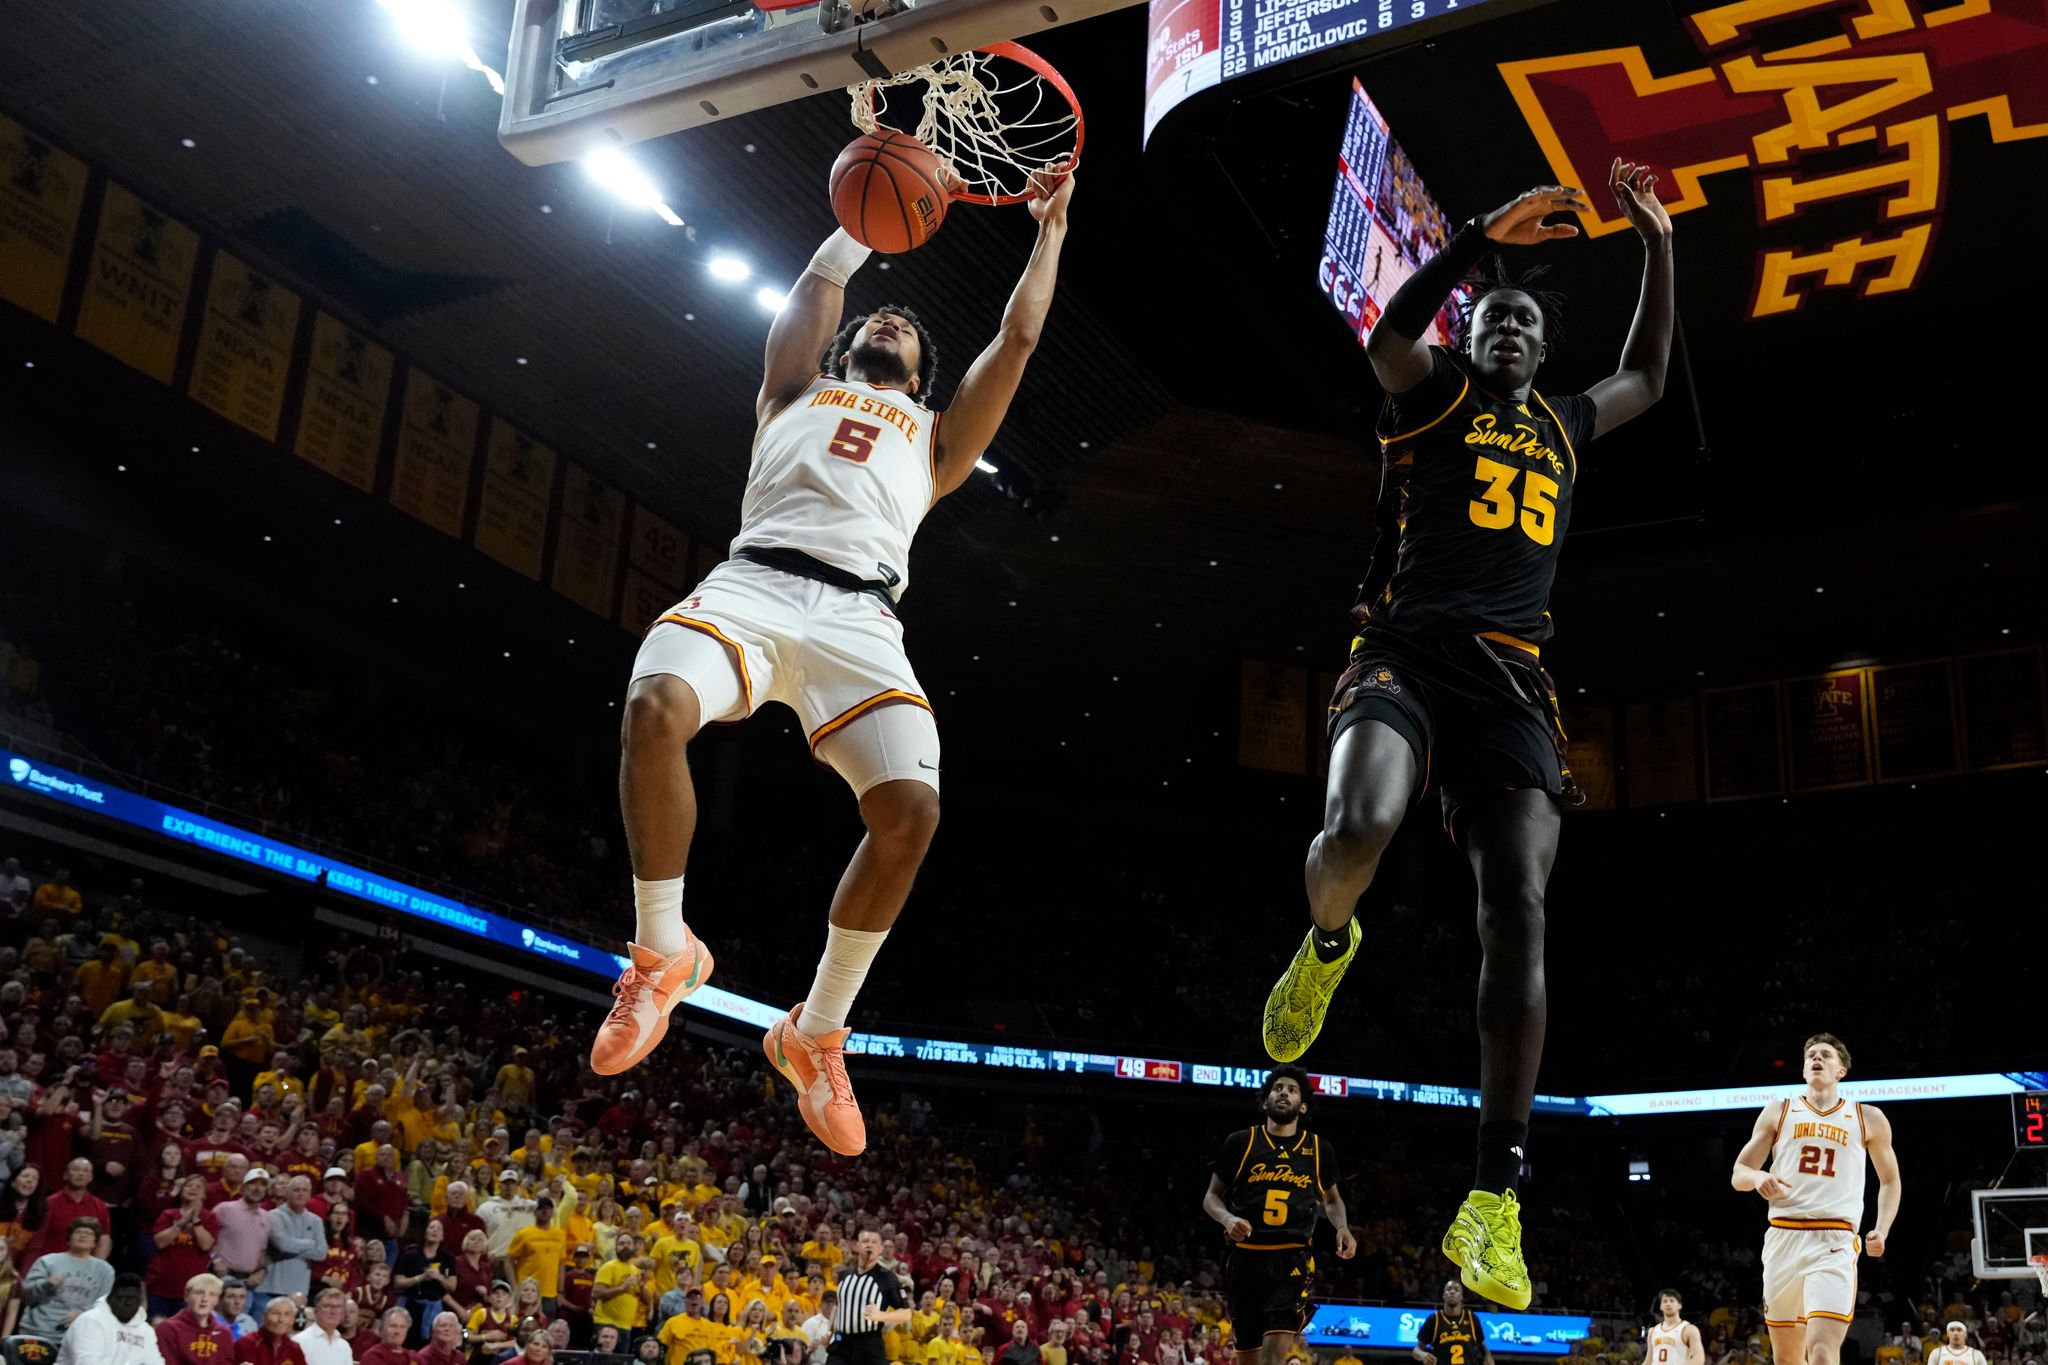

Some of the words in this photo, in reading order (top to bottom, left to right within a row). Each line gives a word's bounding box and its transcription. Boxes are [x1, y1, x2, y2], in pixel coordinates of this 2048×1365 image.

[1230, 10, 1242, 26] 3
[1255, 0, 1314, 18] LIPS
[1223, 57, 1247, 77] 22
[1254, 19, 1367, 68] MOMCILOVIC
[1378, 11, 1393, 29] 8
[1411, 1, 1425, 19] 3
[1224, 41, 1246, 61] 21
[1254, 21, 1312, 51] PLETA
[1230, 26, 1242, 42] 5
[1175, 41, 1204, 70] ISU
[1182, 69, 1193, 92] 7
[808, 388, 859, 409] IOWA
[860, 398, 919, 446] STATE
[827, 417, 882, 465] 5
[1469, 455, 1560, 546] 35
[163, 815, 261, 858] EXPERIENCE
[264, 848, 294, 869] THE
[296, 858, 363, 892] BAKERS
[366, 882, 408, 906] TRUST
[410, 893, 488, 932] DIFFERENCE
[712, 995, 751, 1017] LENDING
[1121, 1058, 1146, 1078] 49
[1196, 1069, 1218, 1082] 2ND
[1318, 1076, 1342, 1095] 45
[1858, 1084, 1947, 1096] MANAGEMENT
[1650, 1098, 1702, 1108] BANKING
[1726, 1092, 1778, 1104] LENDING
[2026, 1097, 2041, 1112] 14
[1793, 1122, 1816, 1139] IOWA
[1817, 1123, 1849, 1147] STATE
[1798, 1145, 1836, 1178] 21
[1248, 1163, 1275, 1183] Sun
[1263, 1189, 1291, 1226] 5
[1450, 1344, 1465, 1364] 2
[1659, 1349, 1667, 1362] 0
